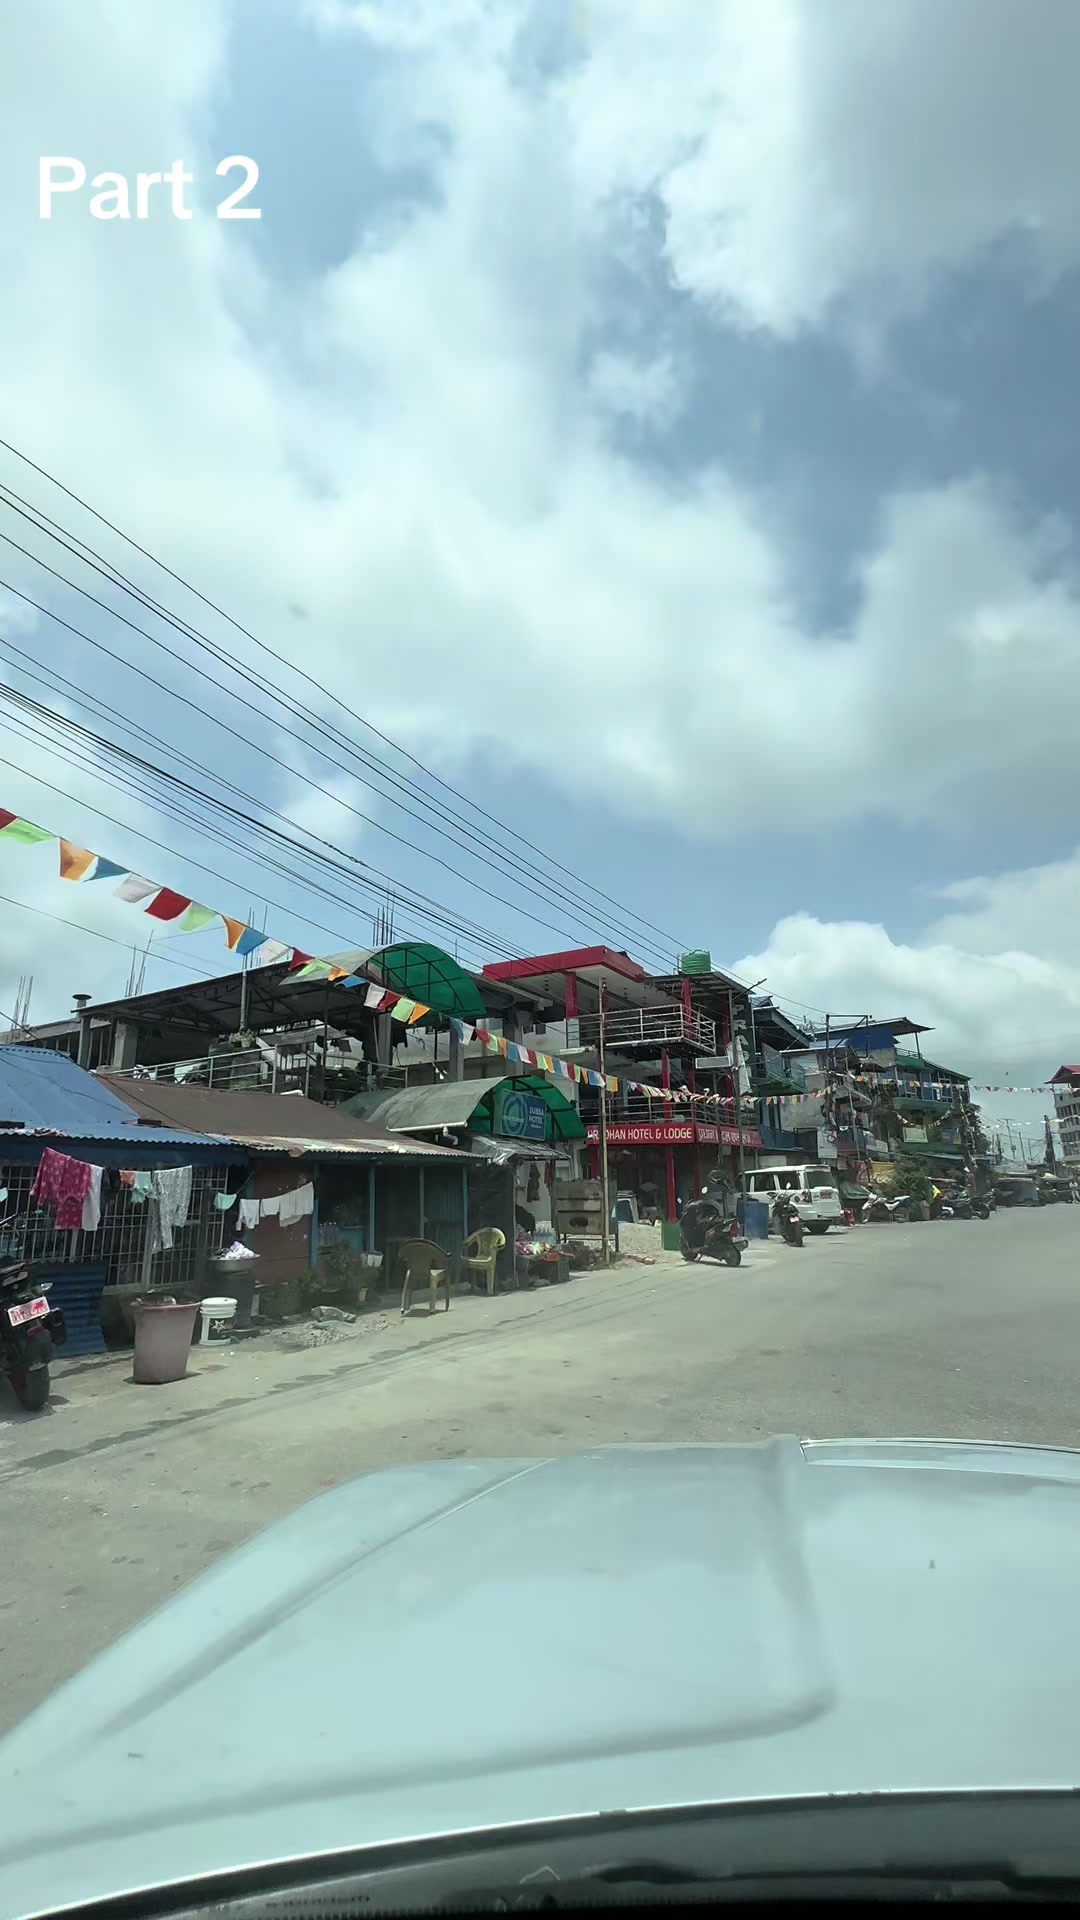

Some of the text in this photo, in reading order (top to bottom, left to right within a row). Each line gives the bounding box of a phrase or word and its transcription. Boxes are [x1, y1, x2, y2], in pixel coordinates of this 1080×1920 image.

[529, 1115, 543, 1125] HOTEL
[628, 1128, 654, 1140] HOTEL
[655, 1128, 662, 1139] &
[664, 1127, 692, 1139] LODGE
